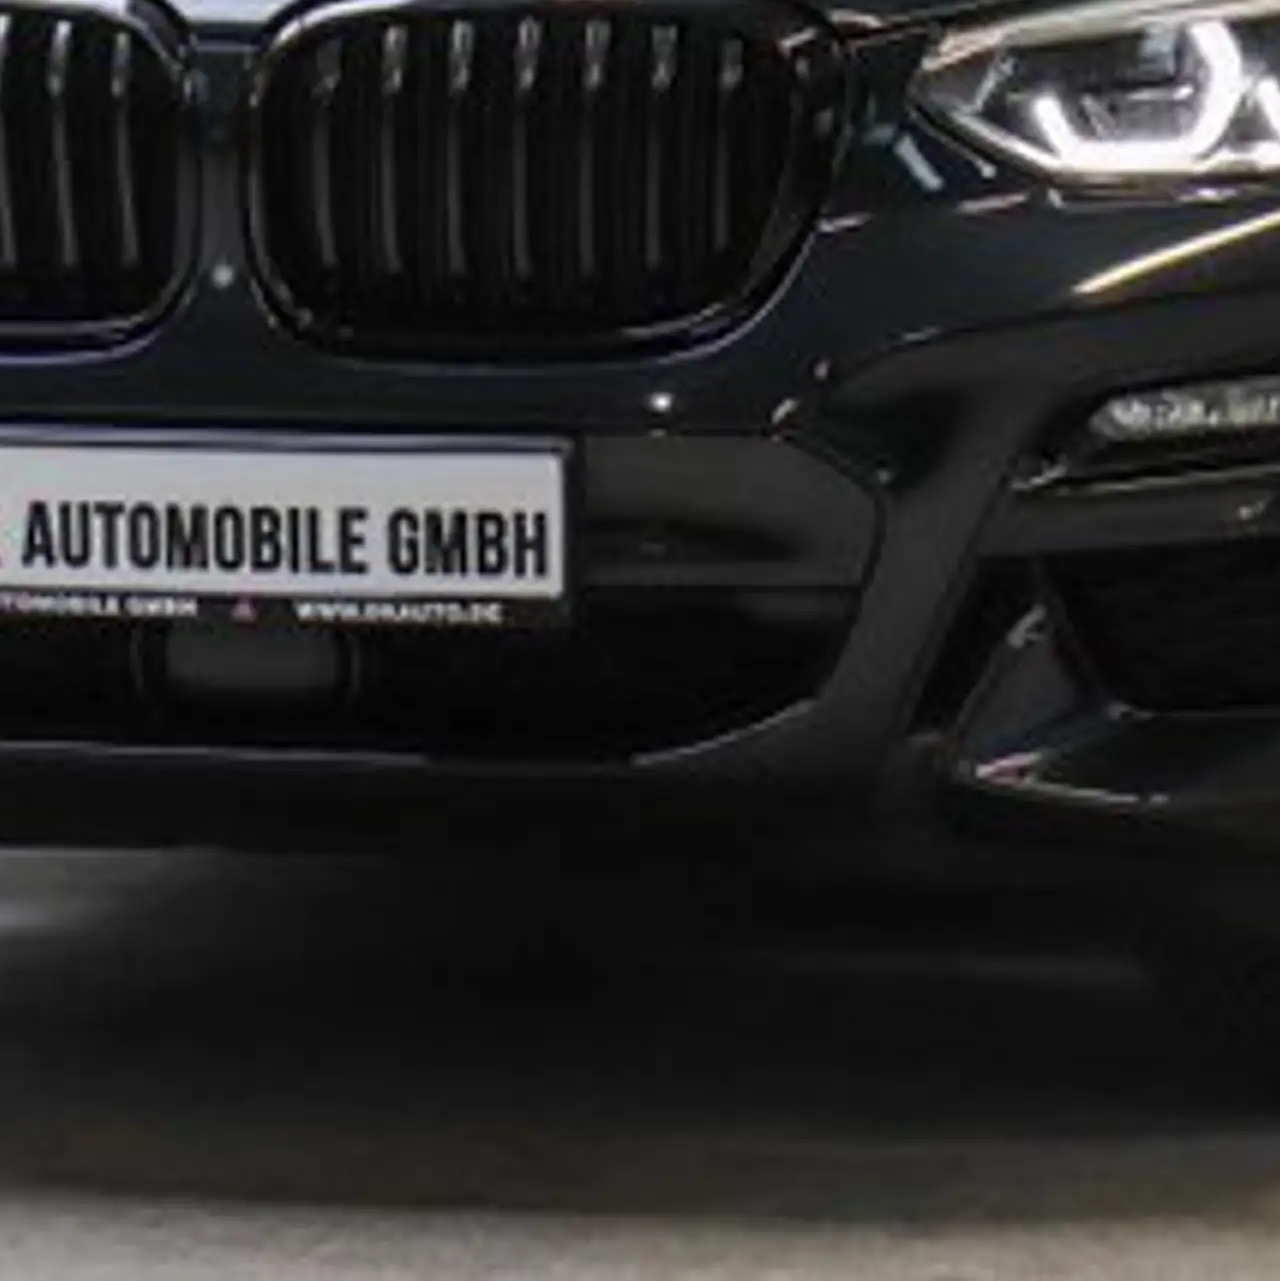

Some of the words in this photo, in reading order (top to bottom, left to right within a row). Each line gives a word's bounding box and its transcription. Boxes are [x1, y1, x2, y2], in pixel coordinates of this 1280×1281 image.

[22, 500, 369, 574] AUTOMOBILE
[386, 506, 548, 579] GMBH
[124, 594, 198, 617] GMBH
